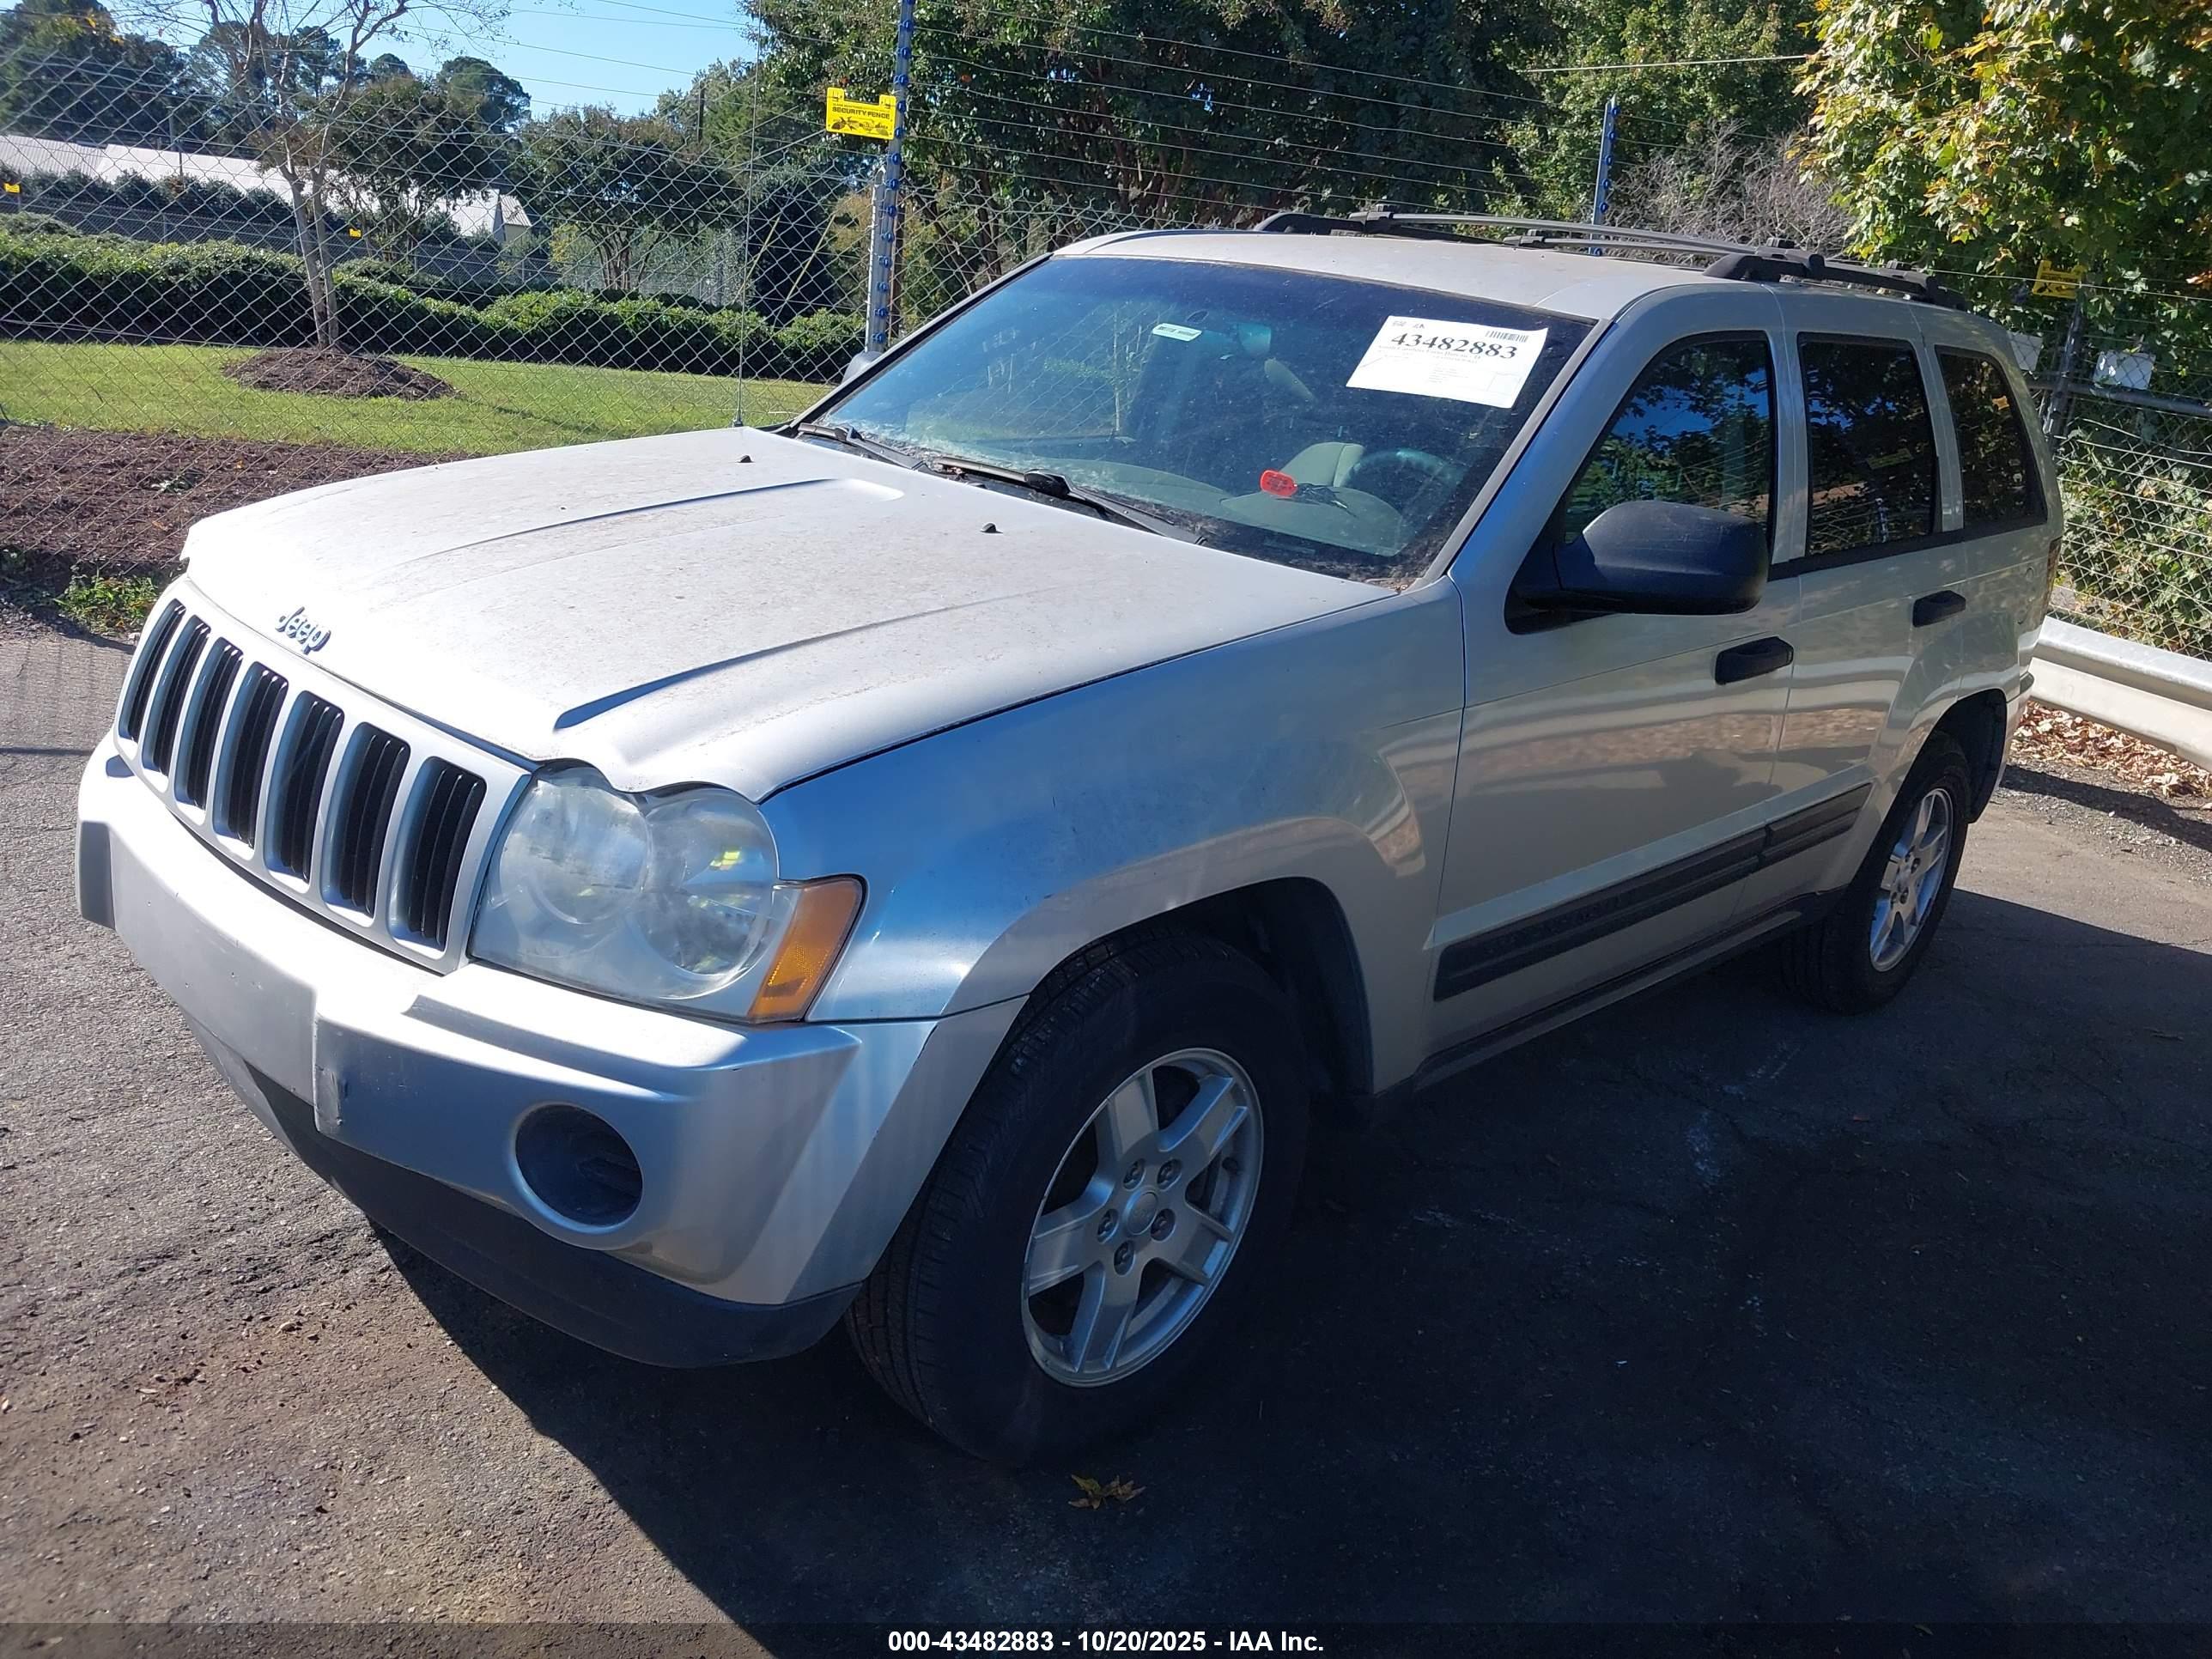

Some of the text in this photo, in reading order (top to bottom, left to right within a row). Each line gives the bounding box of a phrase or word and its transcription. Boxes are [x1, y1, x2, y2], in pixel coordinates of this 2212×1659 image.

[832, 106, 867, 116] SECURITY
[867, 111, 890, 119] FENCE
[1391, 332, 1517, 359] 43482883
[275, 606, 331, 655] Jeep
